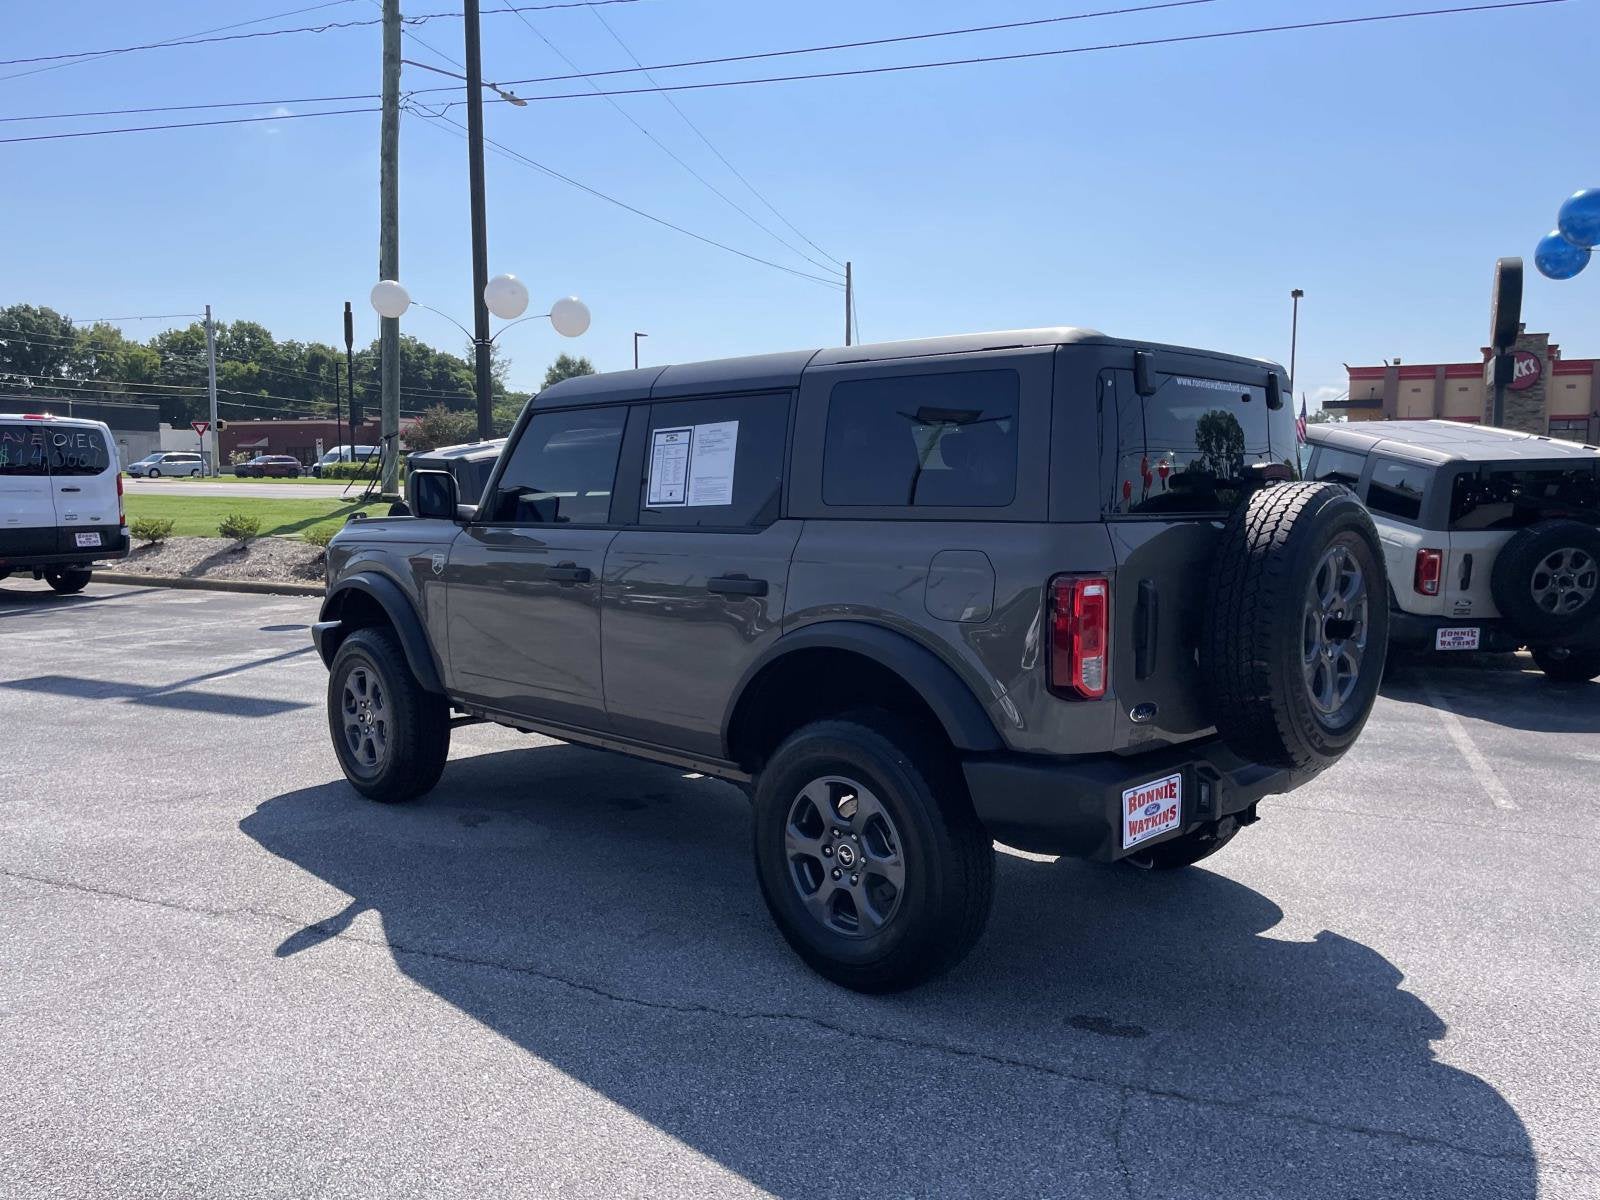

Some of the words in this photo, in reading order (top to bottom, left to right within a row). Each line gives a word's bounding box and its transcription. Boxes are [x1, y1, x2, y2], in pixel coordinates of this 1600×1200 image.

[53, 433, 102, 451] OVER
[1128, 783, 1177, 815] RONNIE
[1128, 804, 1177, 837] WATKINS
